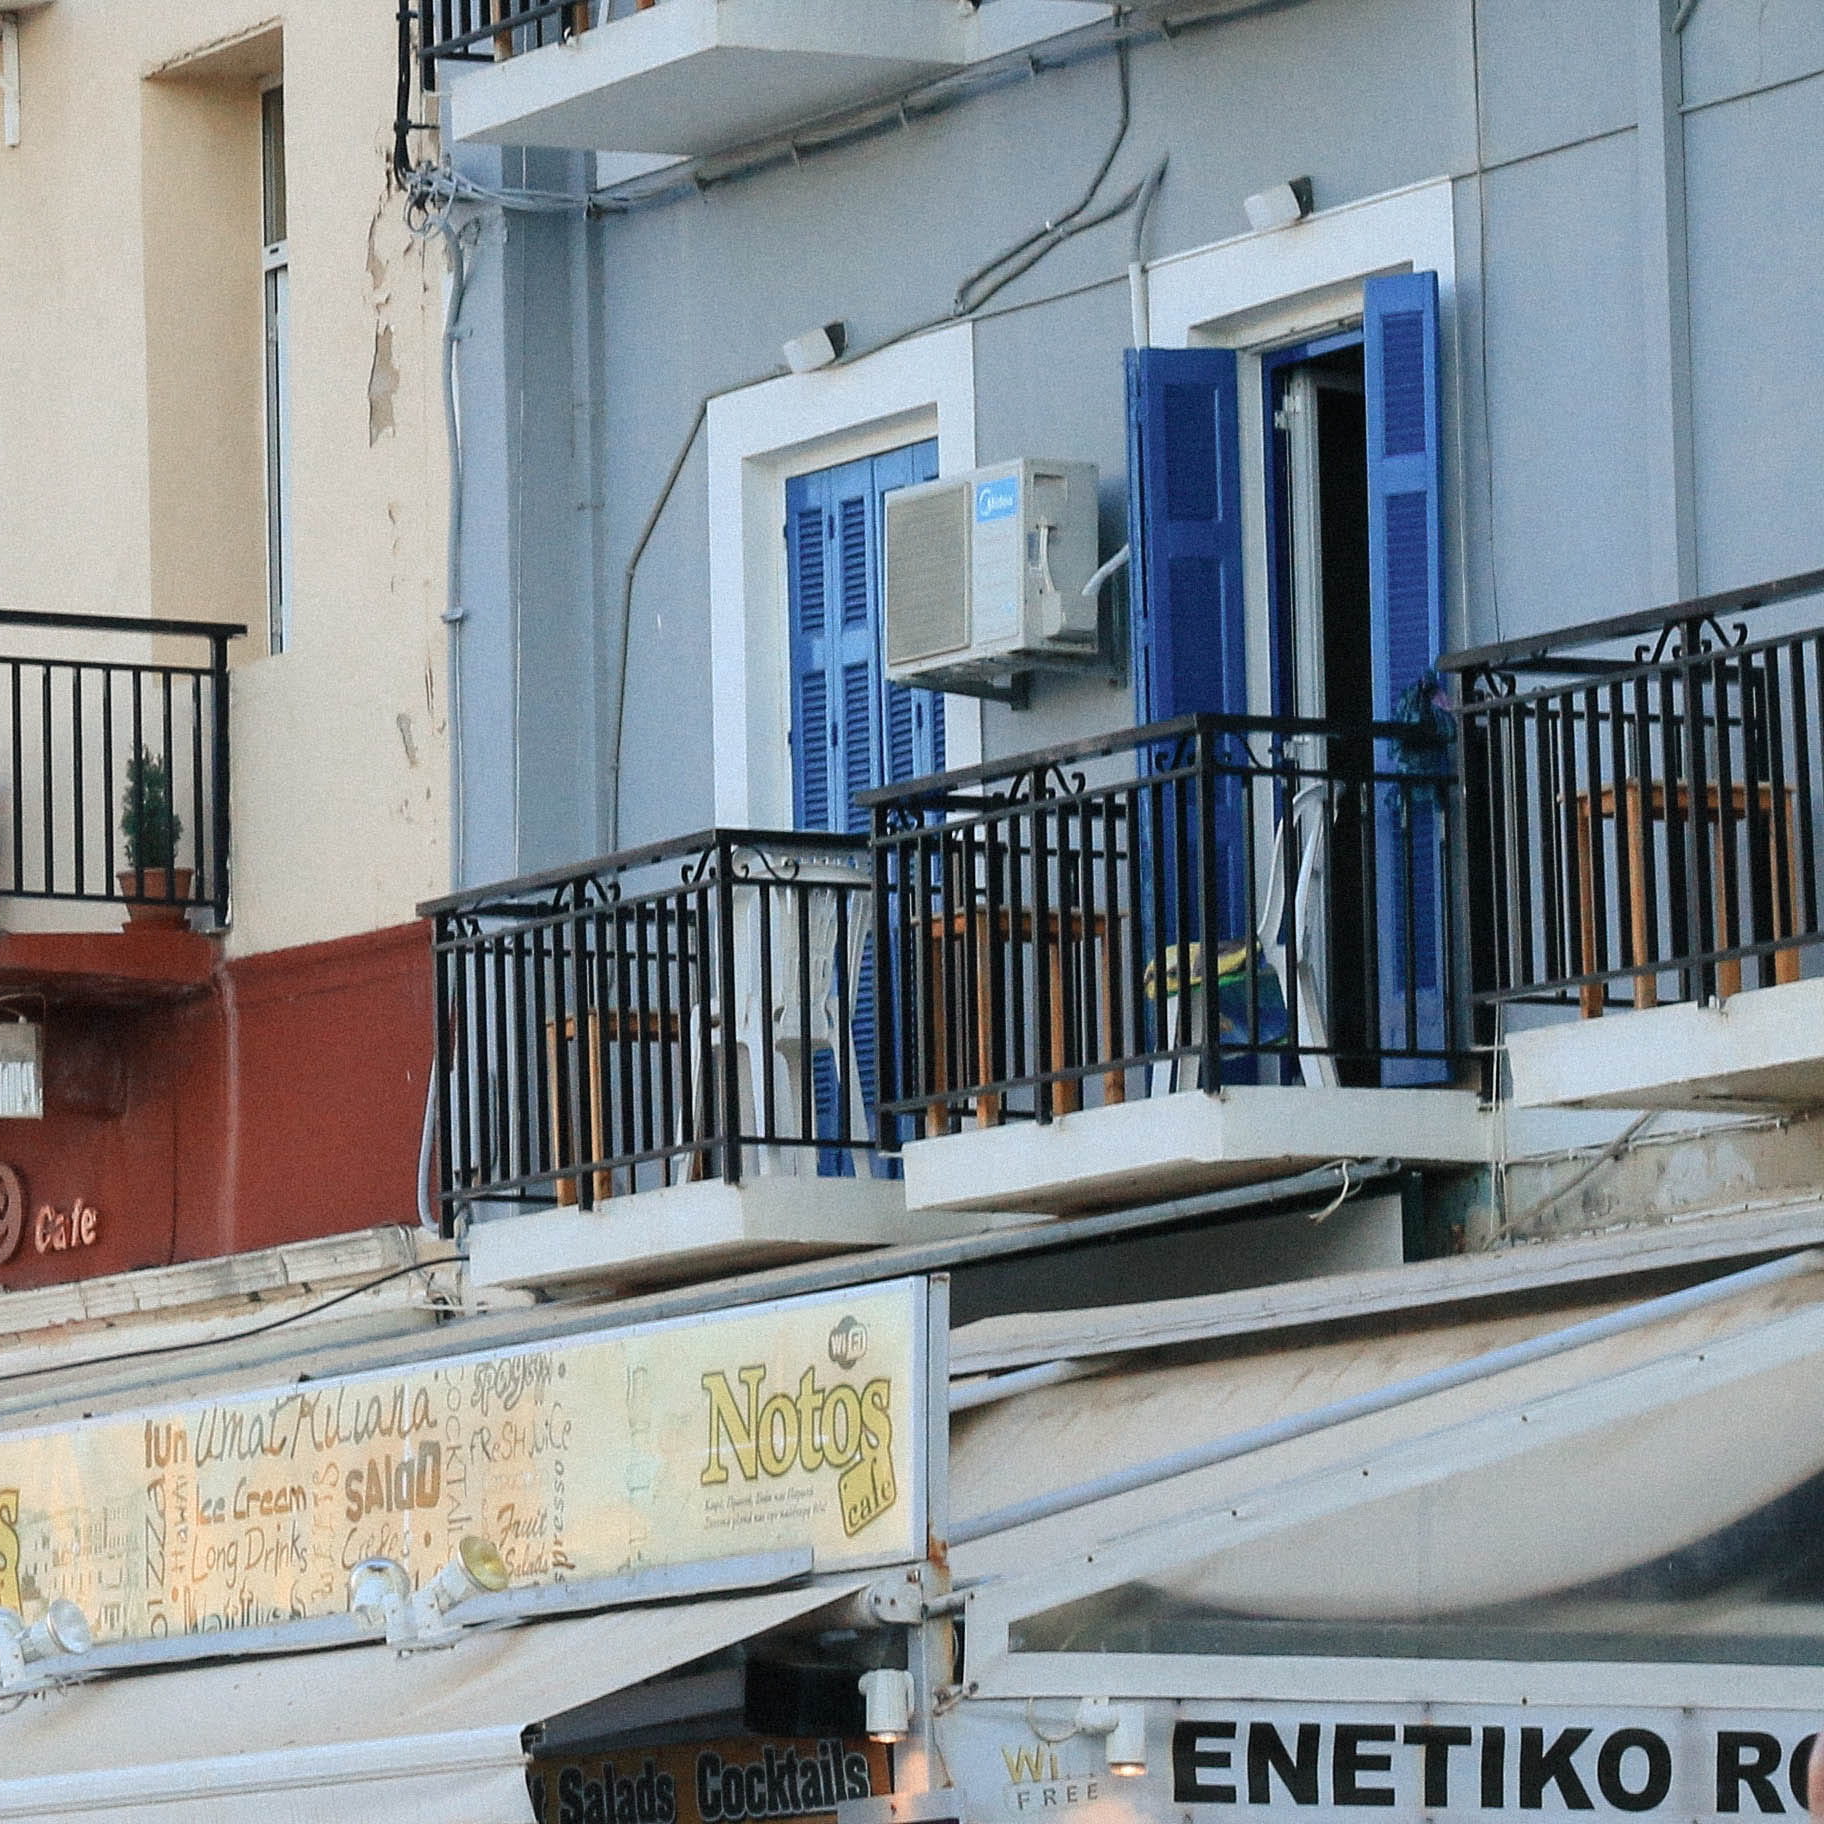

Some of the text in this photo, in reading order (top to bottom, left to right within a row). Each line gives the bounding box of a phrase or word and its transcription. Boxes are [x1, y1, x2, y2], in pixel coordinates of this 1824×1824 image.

[34, 1197, 99, 1255] Cafe
[701, 1365, 893, 1485] Notos
[233, 1477, 307, 1520] Cream
[552, 1460, 575, 1584] spresso
[192, 1520, 307, 1589] Long Drinks
[558, 1757, 677, 1824] Salads
[697, 1738, 872, 1822] Cocktails
[1016, 1782, 1099, 1811] FREE
[1173, 1721, 1815, 1814] ENETIKO R
